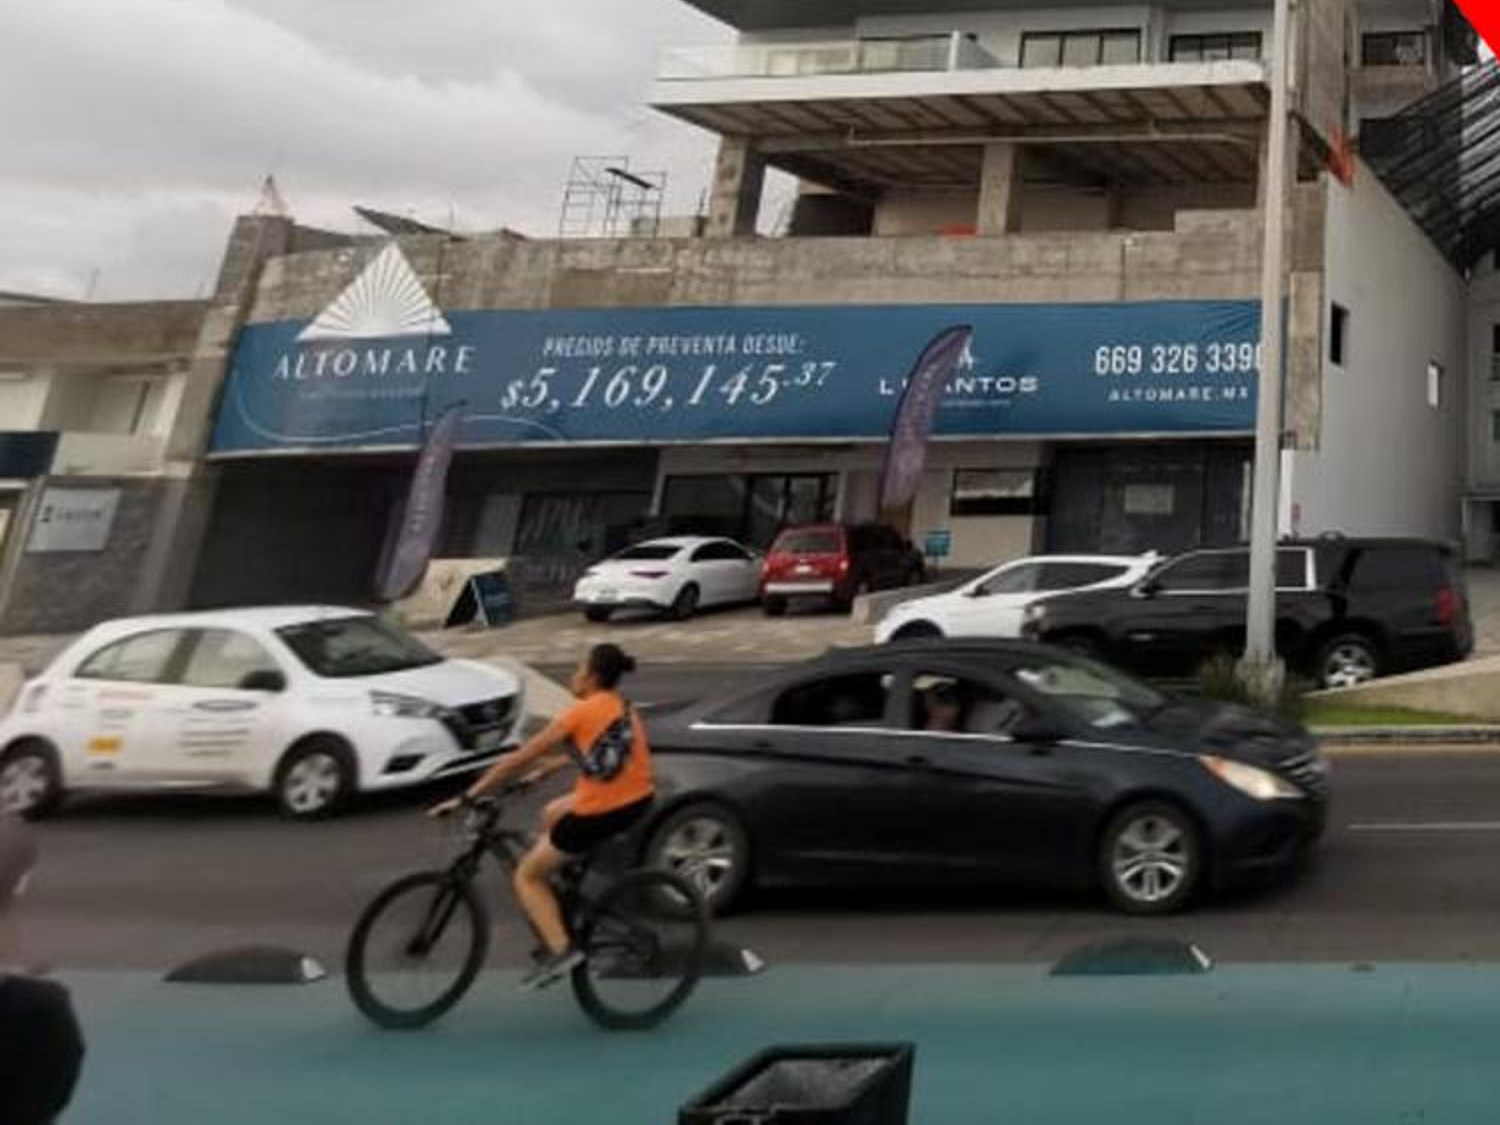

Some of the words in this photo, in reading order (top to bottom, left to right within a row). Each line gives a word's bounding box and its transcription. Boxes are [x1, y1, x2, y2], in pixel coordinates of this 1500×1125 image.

[543, 335, 613, 357] PRECIOS
[618, 335, 641, 356] DE
[645, 334, 736, 355] PREVENTA
[742, 332, 804, 355] DESDE:
[1095, 345, 1142, 374] 669
[1151, 344, 1198, 374] 326
[272, 345, 476, 380] ALTOMARE
